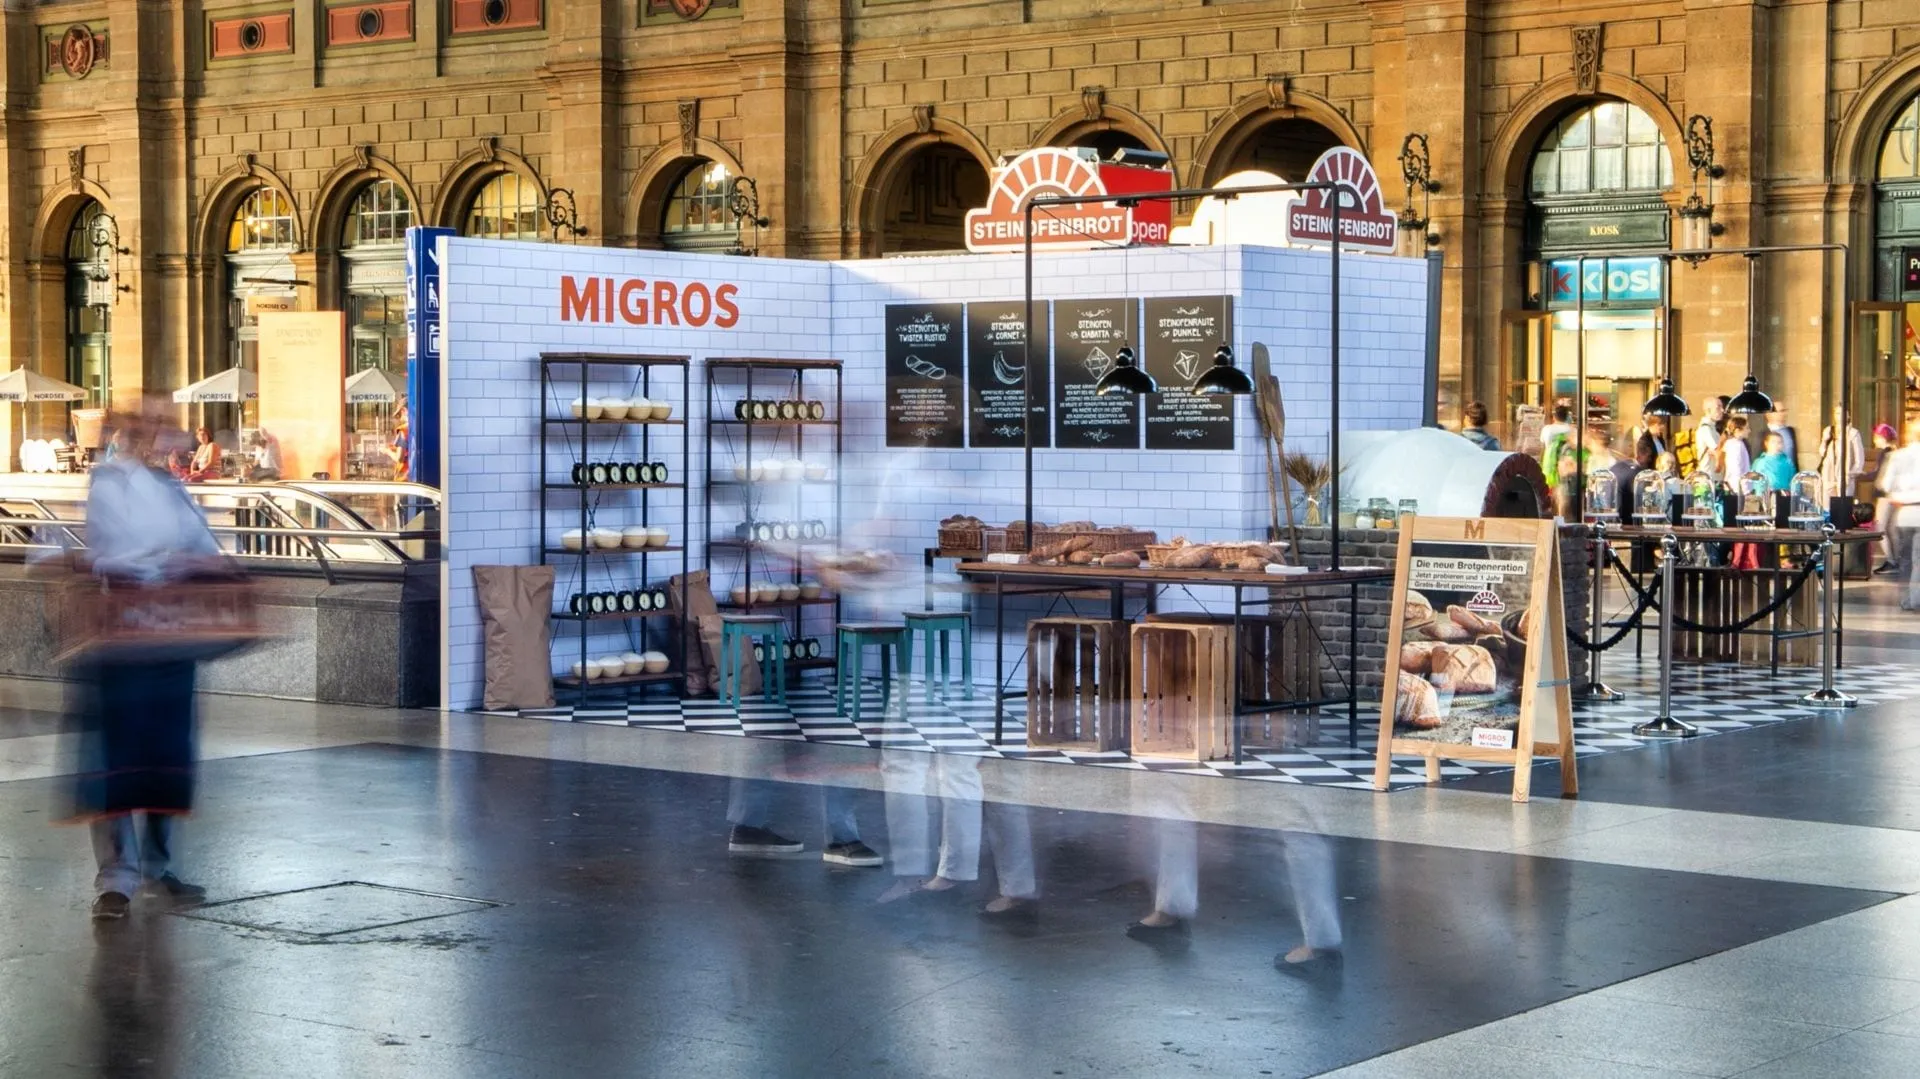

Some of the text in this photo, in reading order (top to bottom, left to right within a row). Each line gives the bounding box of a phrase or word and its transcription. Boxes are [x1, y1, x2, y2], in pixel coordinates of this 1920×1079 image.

[1589, 225, 1620, 236] KIOSK
[561, 275, 740, 329] MIGROS
[995, 331, 1020, 340] CORNET
[1172, 328, 1202, 338] DUNKEL
[1464, 519, 1485, 539] M
[1416, 559, 1431, 568] Die
[1457, 561, 1524, 573] Brotgeneration
[1415, 571, 1432, 579] Jetzt
[1433, 573, 1464, 581] probieren
[1478, 733, 1506, 741] MIGROS
